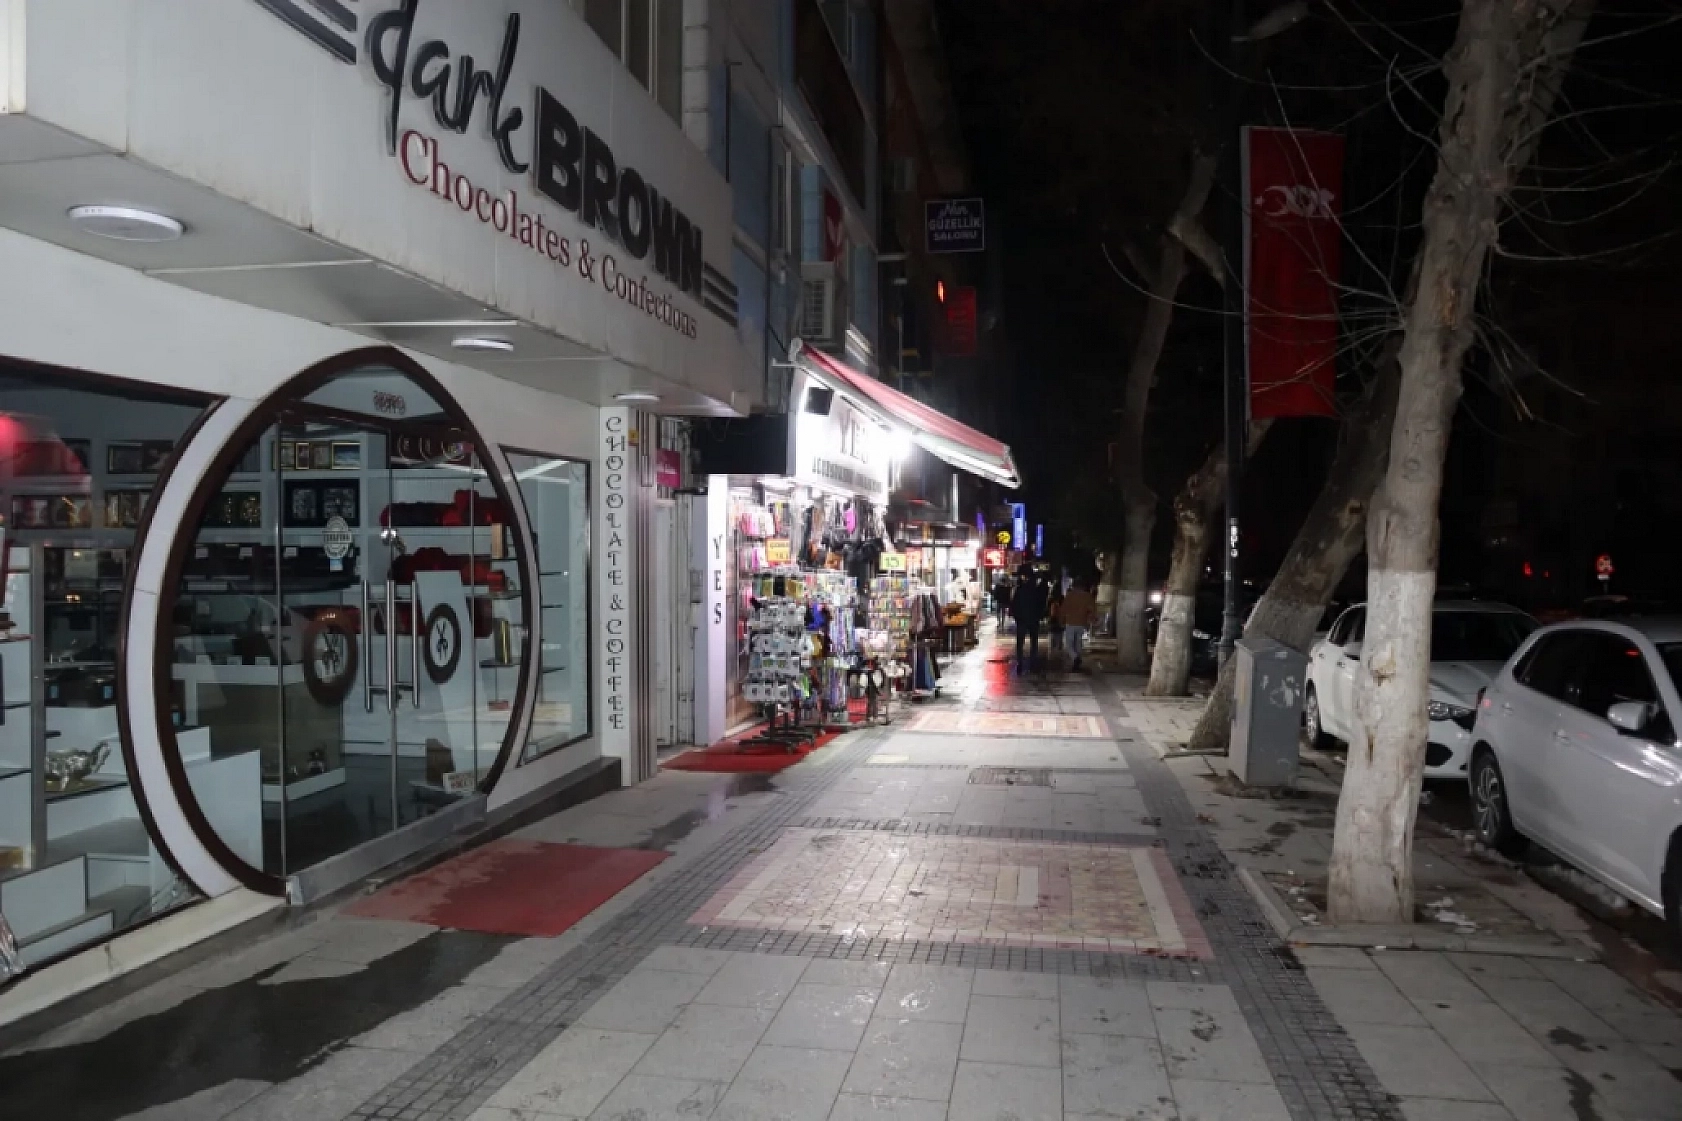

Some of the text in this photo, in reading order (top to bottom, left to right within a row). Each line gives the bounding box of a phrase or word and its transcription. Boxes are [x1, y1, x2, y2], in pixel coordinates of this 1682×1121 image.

[364, 0, 702, 299] dark BROWN
[400, 130, 697, 339] Chocolates & Confections
[605, 416, 626, 730] CHOCOLATE & COFFEE
[713, 534, 723, 624] YES
